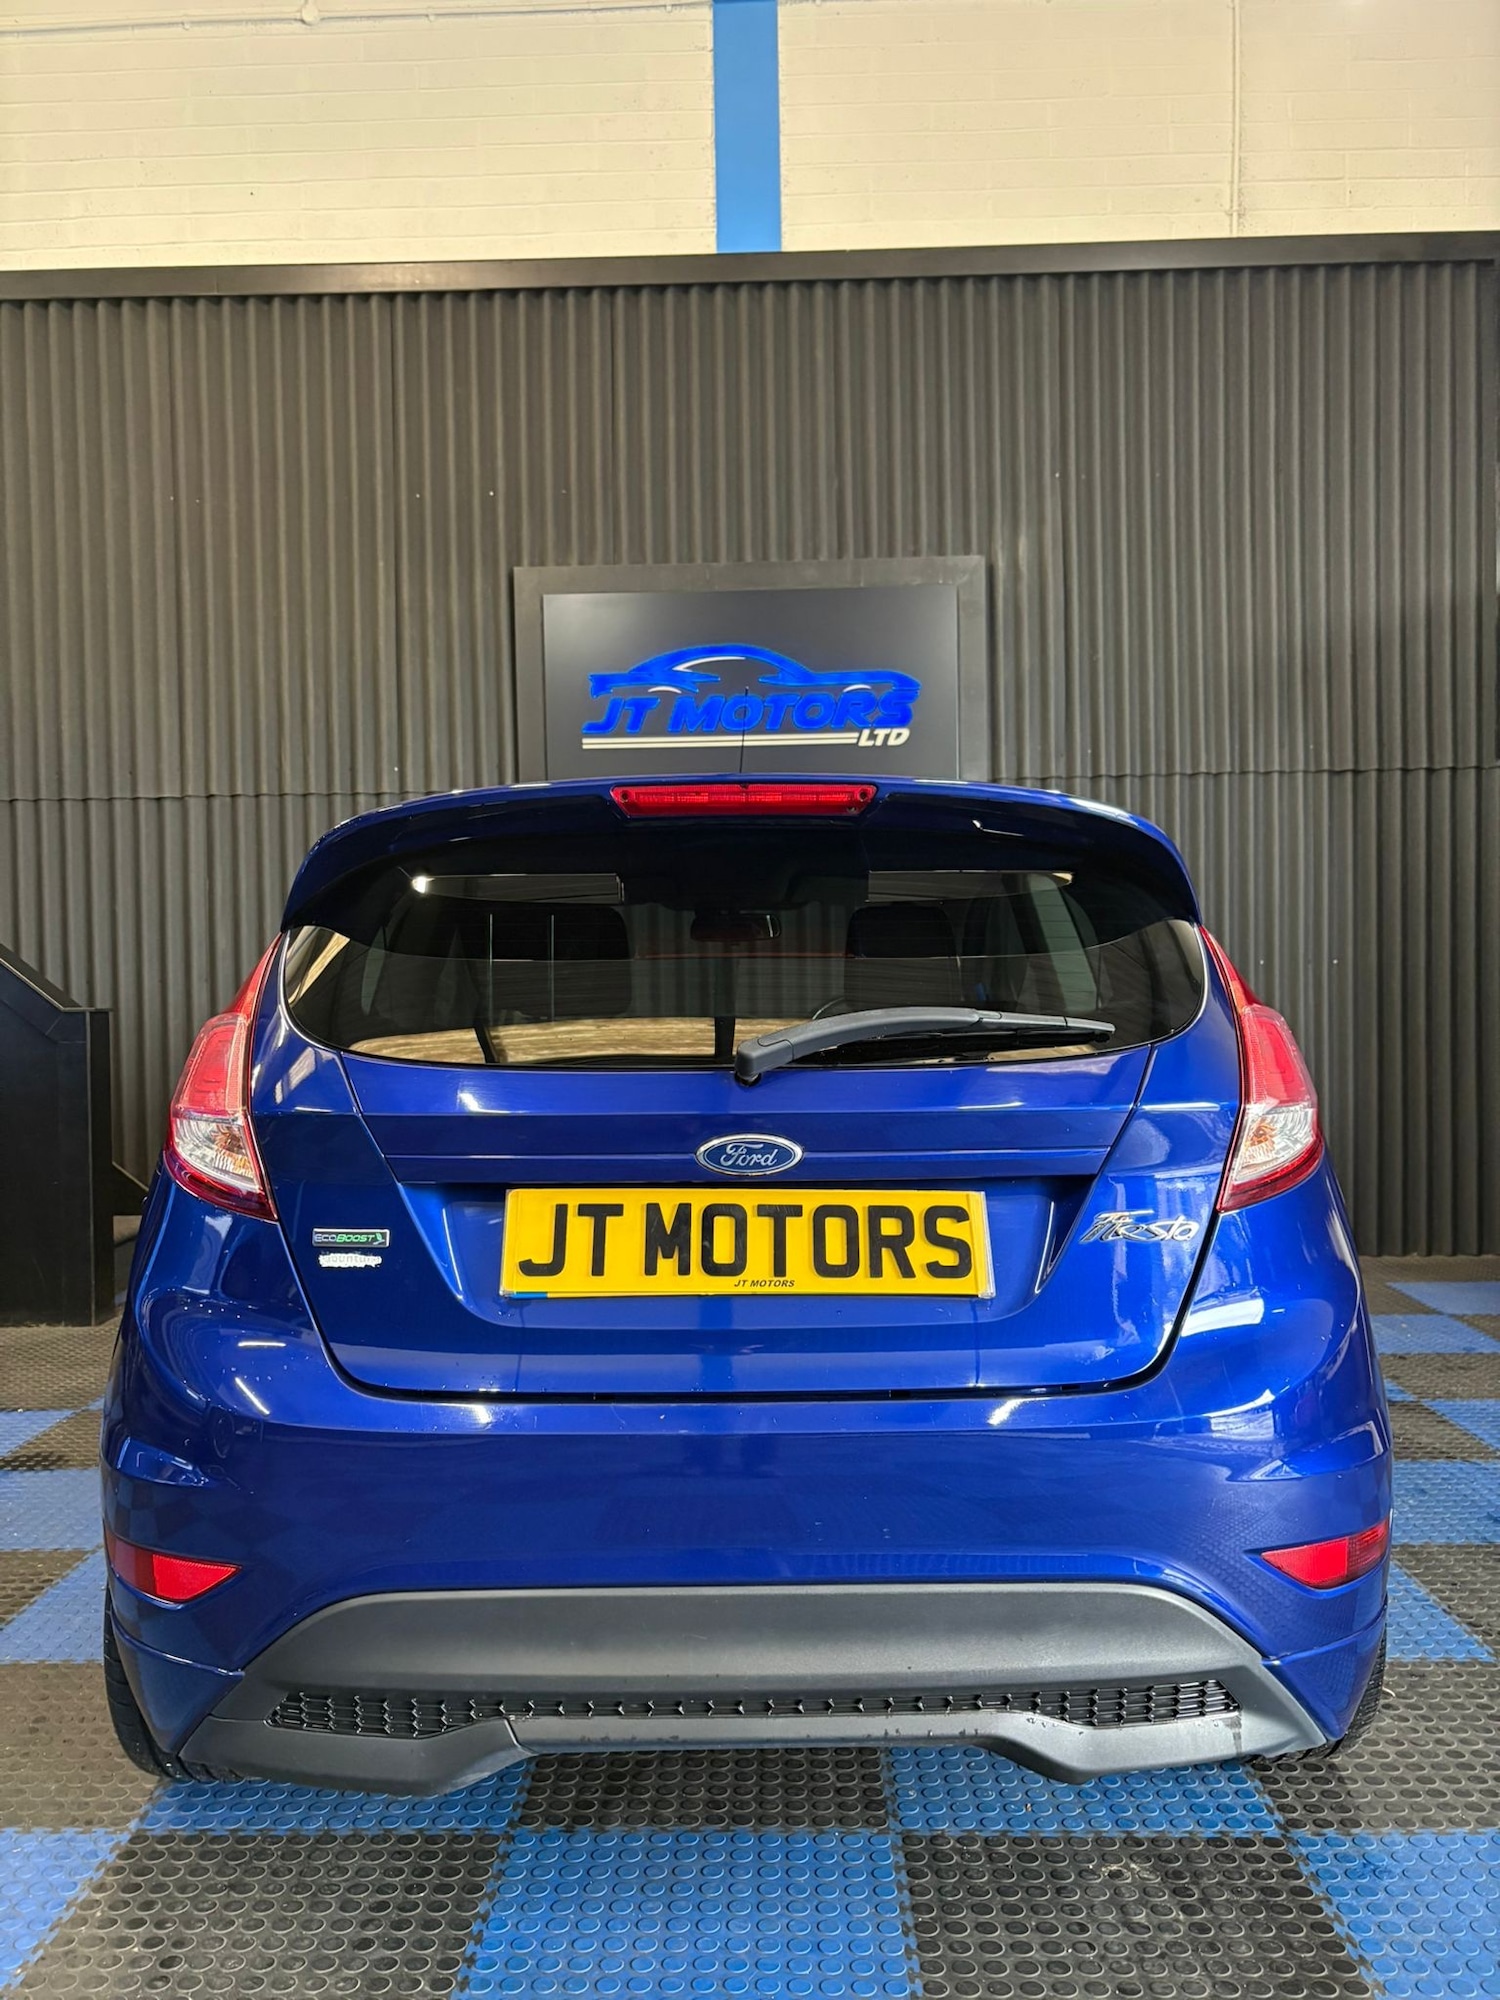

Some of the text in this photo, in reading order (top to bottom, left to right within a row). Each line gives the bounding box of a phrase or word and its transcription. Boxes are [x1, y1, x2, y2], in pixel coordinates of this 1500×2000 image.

[581, 690, 919, 734] JT MOTORS
[857, 727, 911, 748] LTD
[720, 1142, 778, 1166] Ford
[518, 1202, 972, 1279] JT MOTORS
[734, 1279, 795, 1288] JT MOTORS
